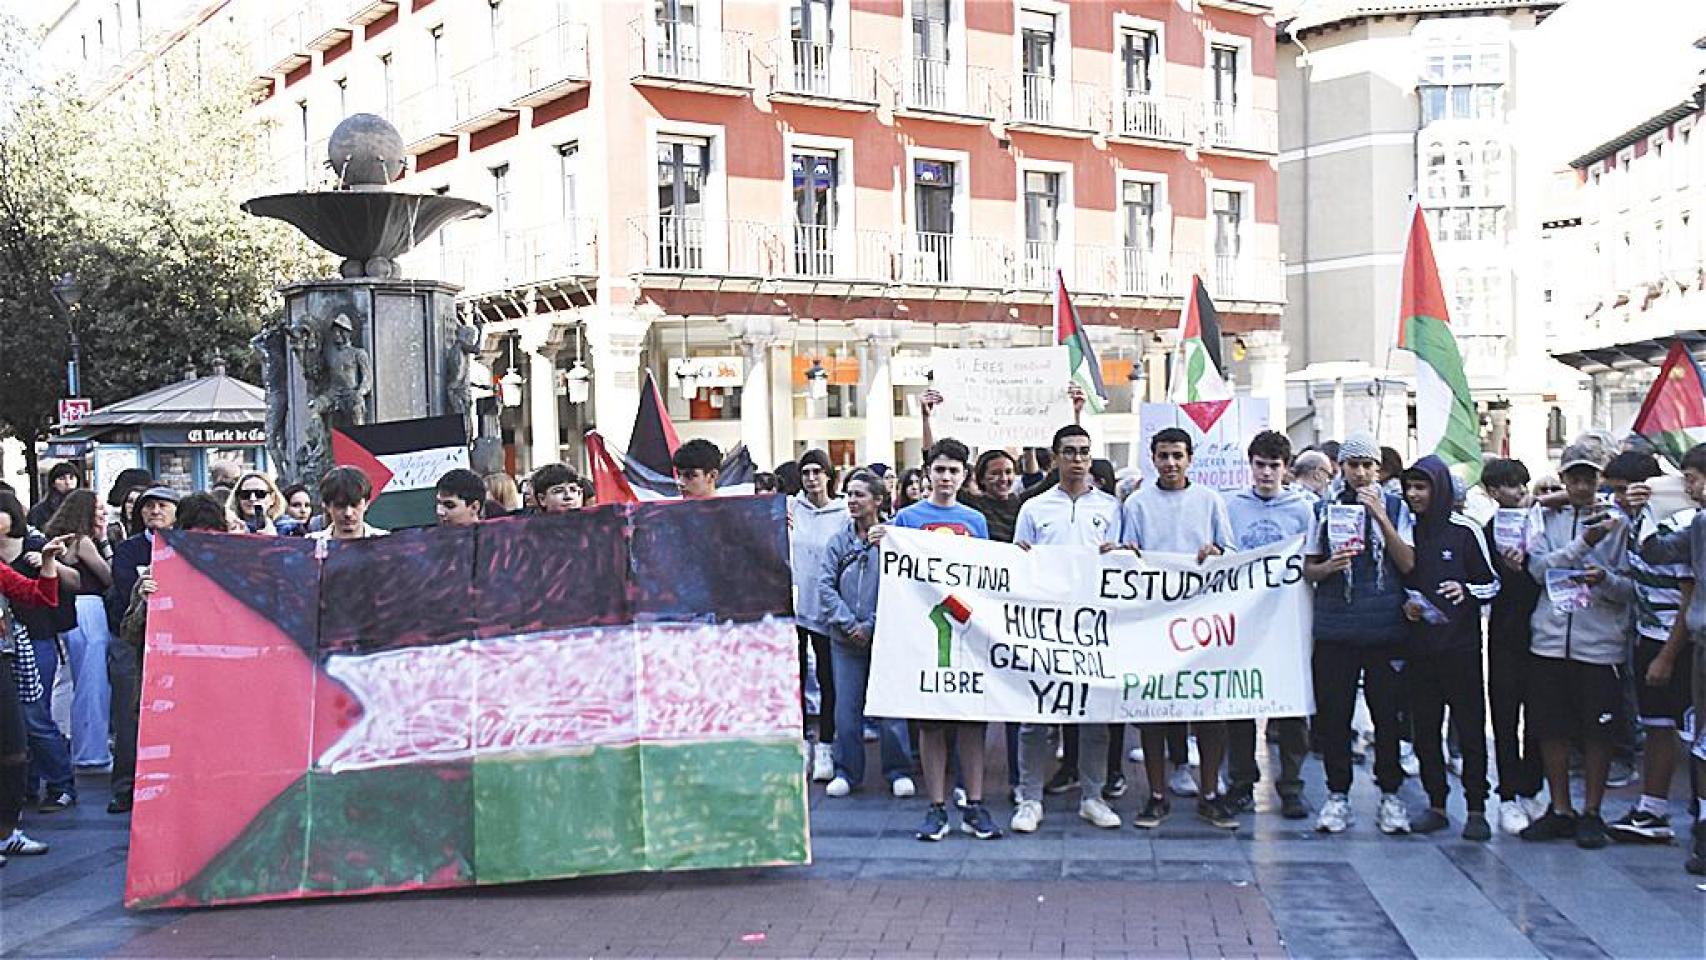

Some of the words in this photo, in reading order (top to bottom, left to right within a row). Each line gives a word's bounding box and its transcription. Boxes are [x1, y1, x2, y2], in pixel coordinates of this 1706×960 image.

[973, 357, 1004, 373] ERES
[188, 429, 202, 442] El
[205, 429, 234, 441] Norte
[235, 429, 247, 441] de
[248, 428, 266, 441] Ca
[884, 551, 1010, 592] PALESTINA
[1100, 554, 1304, 602] ESTUDIANTES
[1004, 603, 1109, 647] HUELGA
[1169, 612, 1236, 652] CON
[990, 643, 1116, 679] GENERAL
[920, 670, 985, 694] LIBRE
[1029, 679, 1090, 716] YA!
[1123, 667, 1264, 701] PALESTINA
